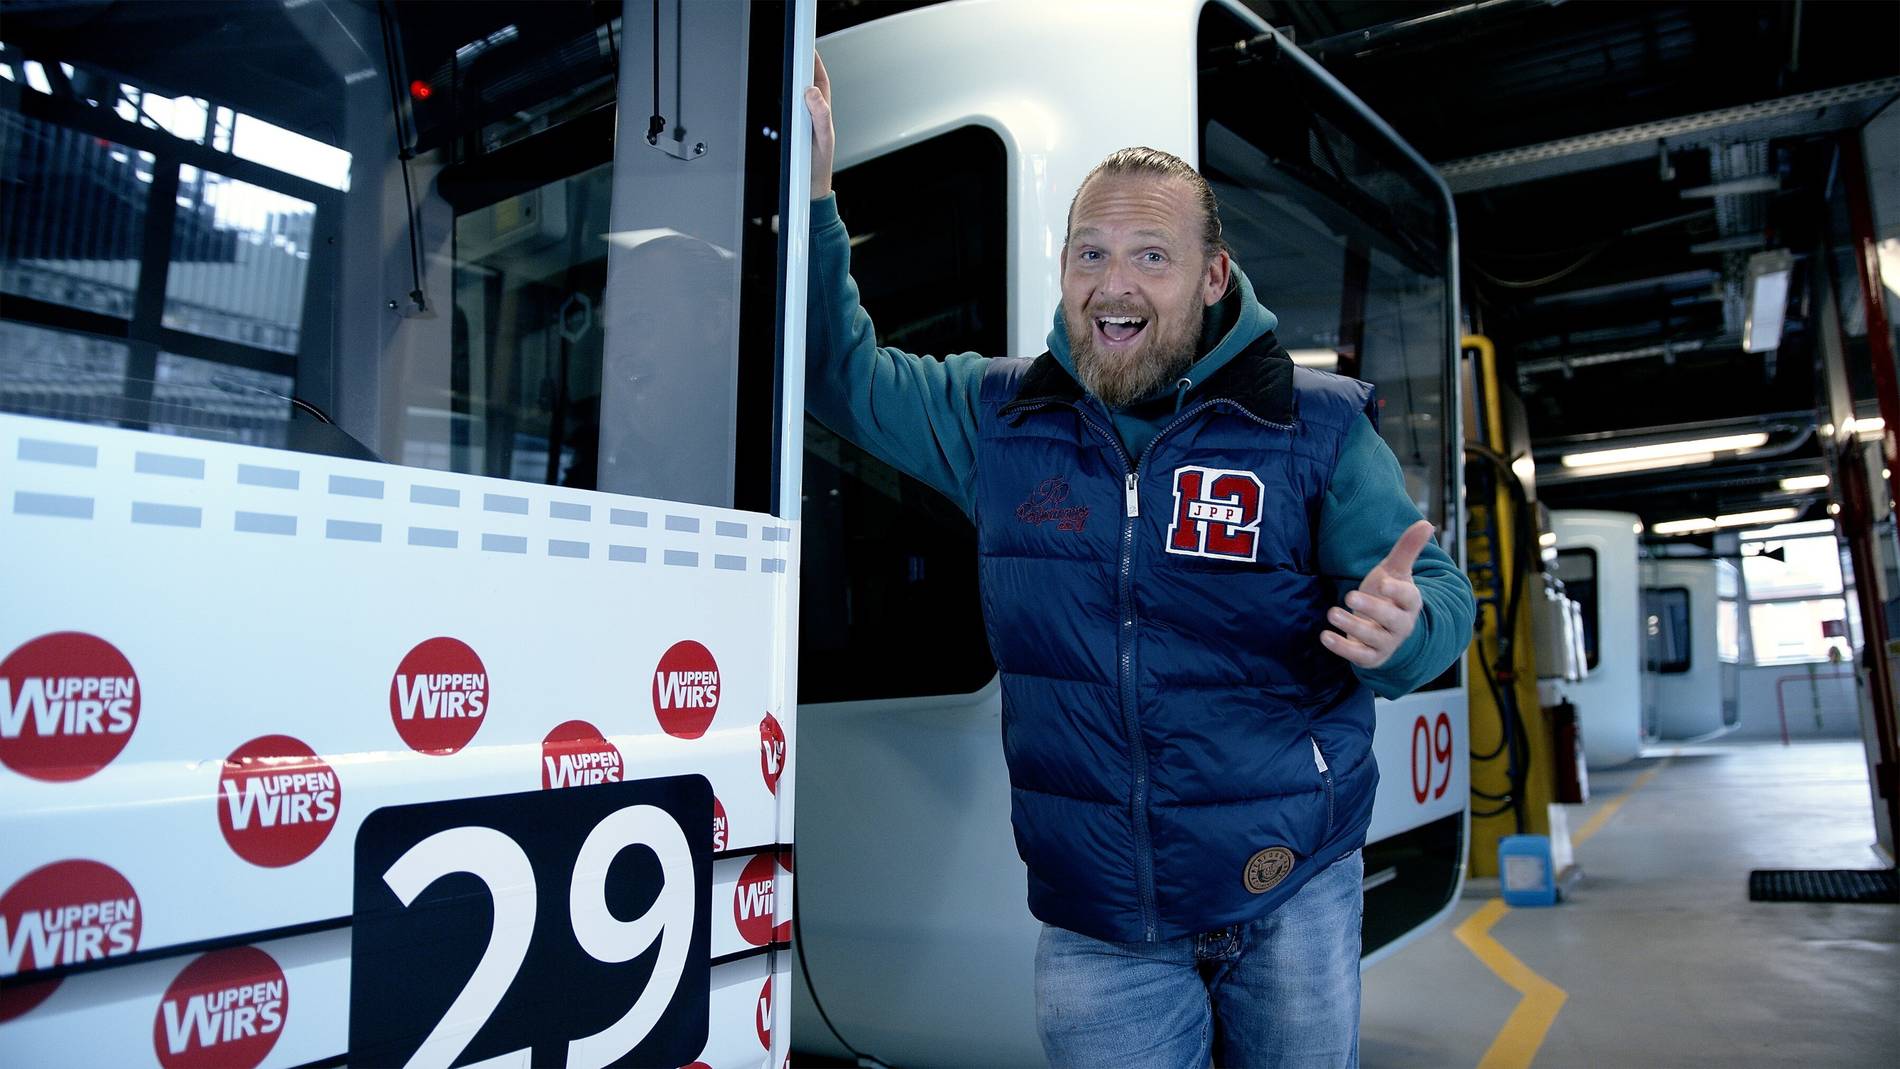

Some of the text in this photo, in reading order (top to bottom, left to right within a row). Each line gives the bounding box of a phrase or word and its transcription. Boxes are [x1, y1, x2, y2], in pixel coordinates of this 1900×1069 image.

[1166, 465, 1265, 562] 12
[1412, 712, 1453, 804] 09
[382, 804, 696, 1069] 29
